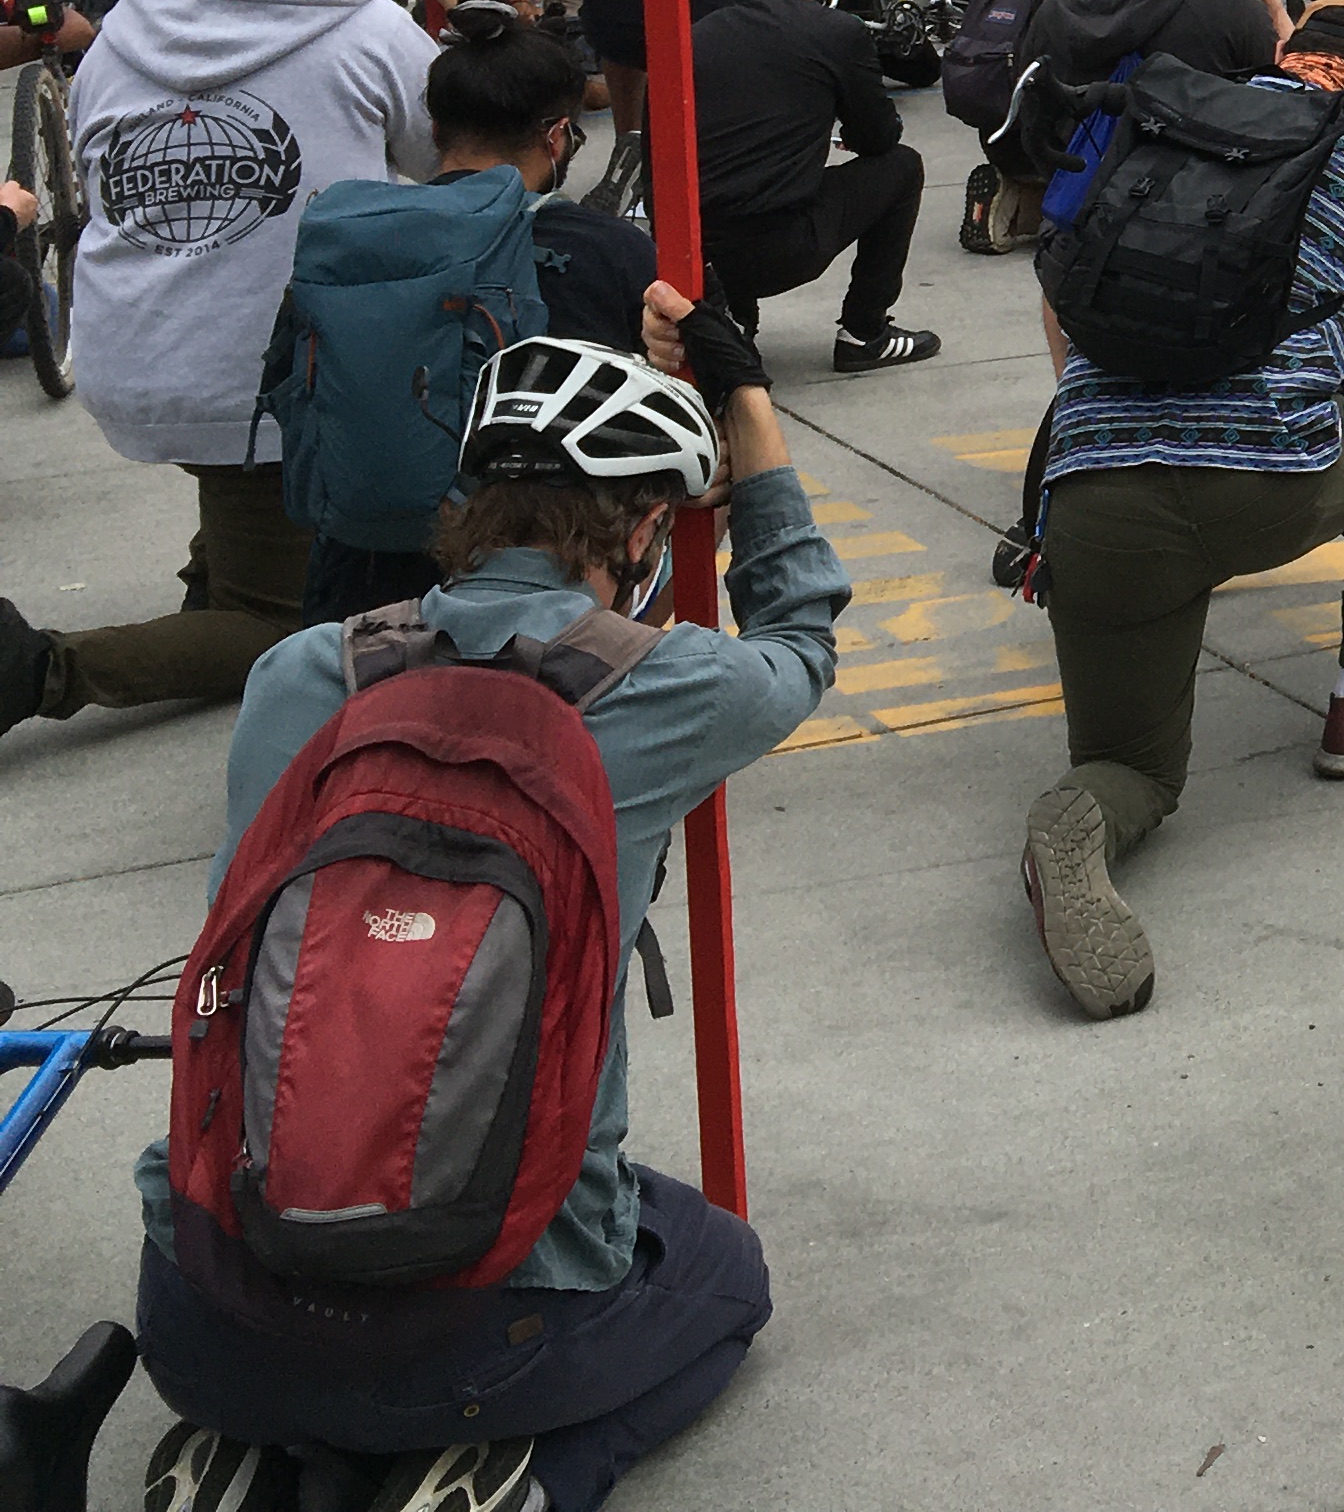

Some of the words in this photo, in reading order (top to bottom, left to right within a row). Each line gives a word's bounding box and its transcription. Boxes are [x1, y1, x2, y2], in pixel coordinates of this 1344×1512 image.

[188, 94, 260, 122] CALIFORNIA
[109, 159, 285, 200] FEDERATION
[144, 184, 236, 206] BREWING
[154, 245, 182, 257] EST
[186, 240, 221, 257] 2014
[362, 910, 413, 933] NORTH
[386, 908, 415, 921] THE
[368, 927, 408, 942] FACE
[293, 1296, 370, 1322] VAULT
